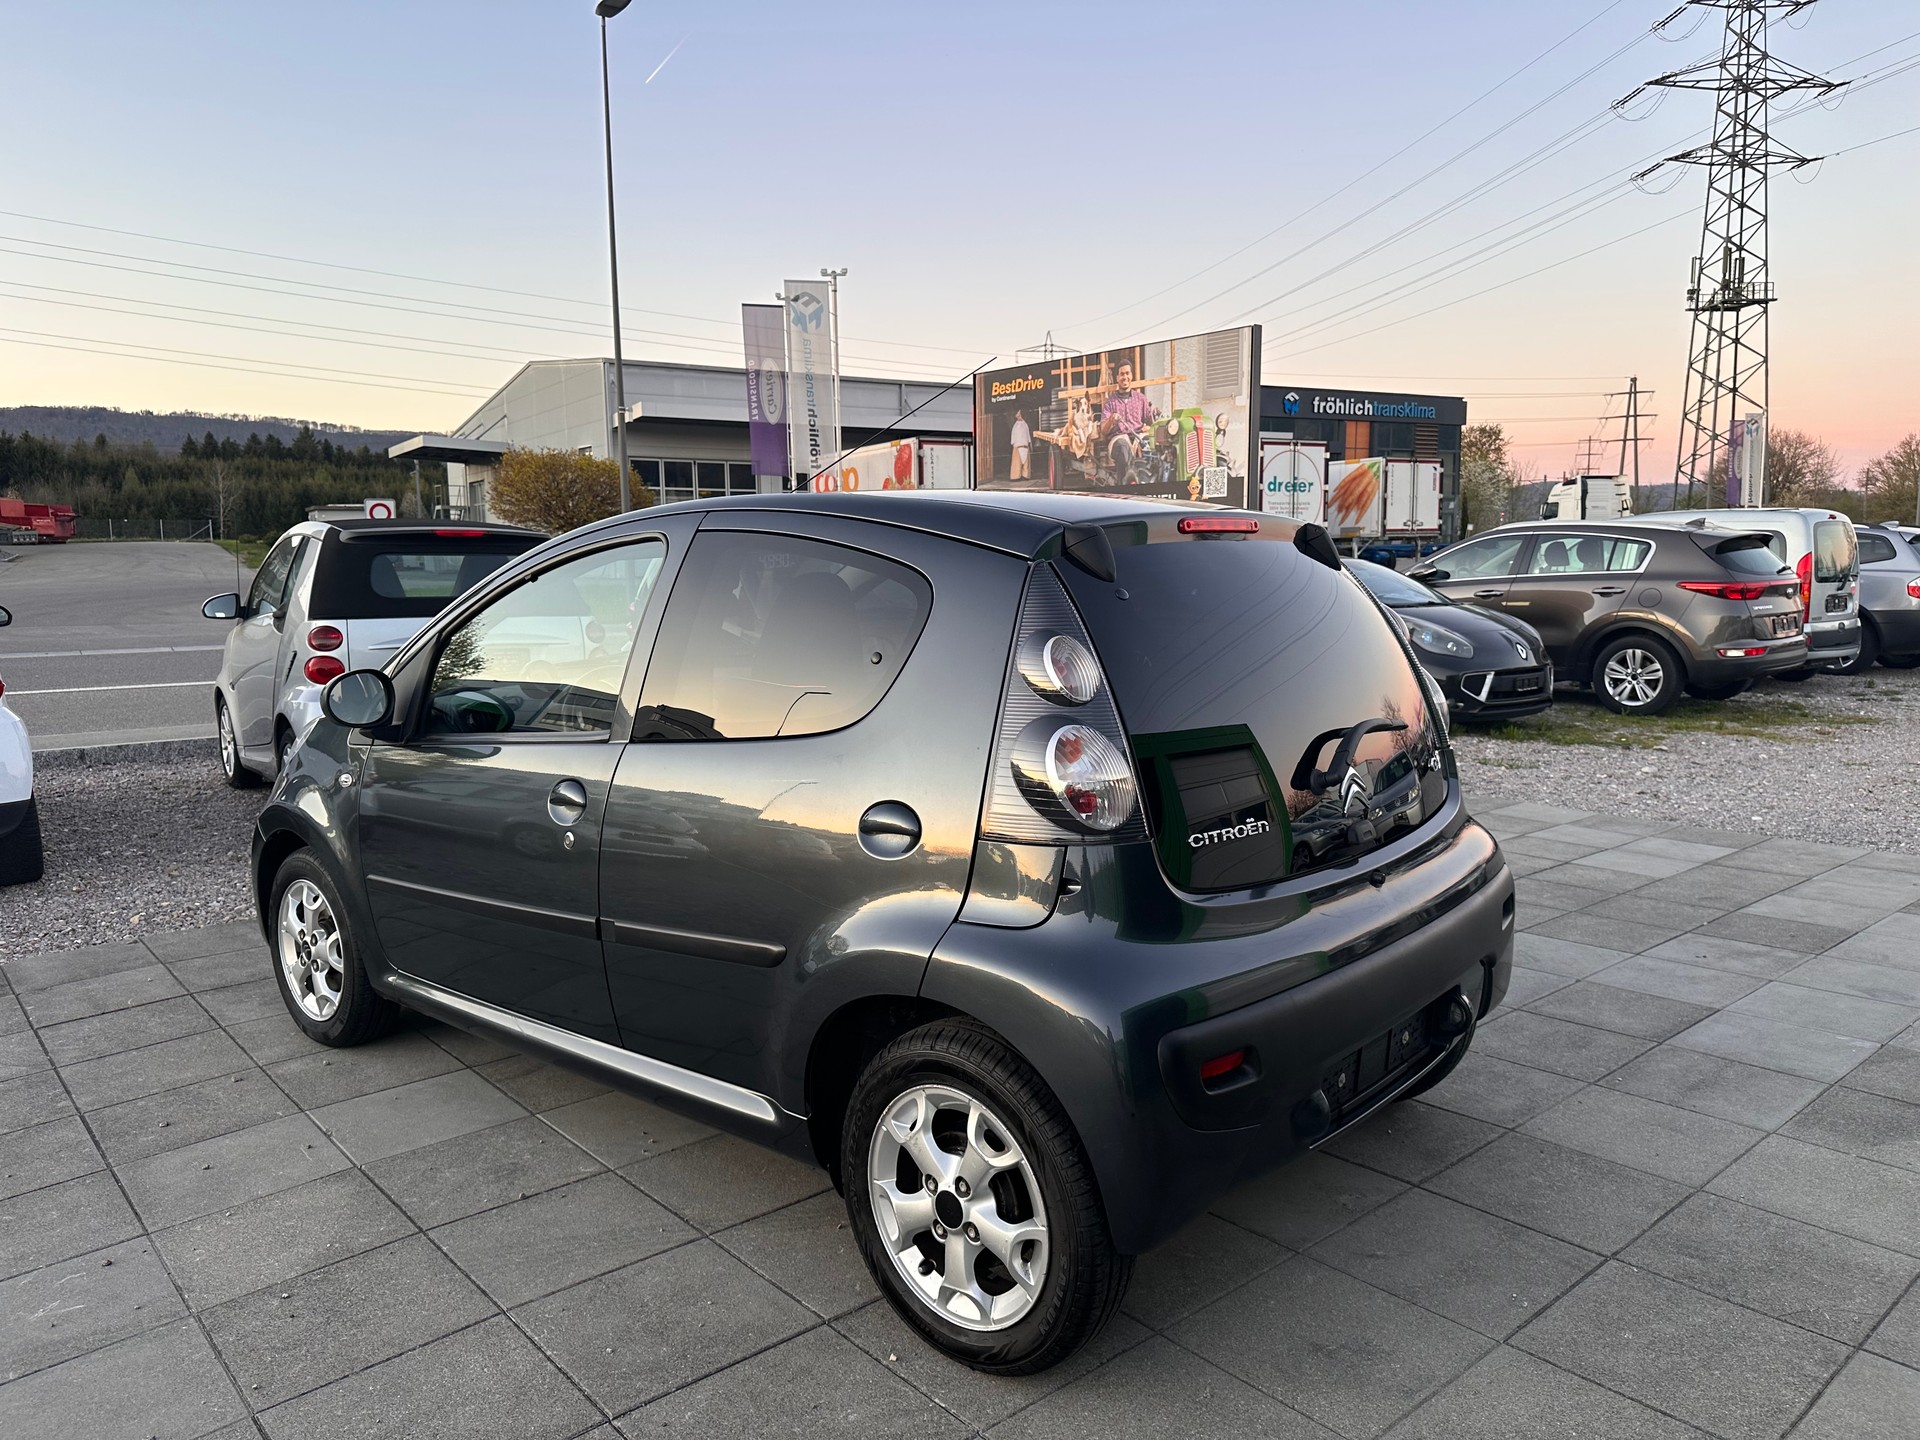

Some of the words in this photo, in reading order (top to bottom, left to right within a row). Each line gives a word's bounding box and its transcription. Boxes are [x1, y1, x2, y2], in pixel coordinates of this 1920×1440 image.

[991, 374, 1044, 396] BestDrive
[1267, 476, 1314, 493] dreier
[1038, 1252, 1067, 1336] SAILUN
